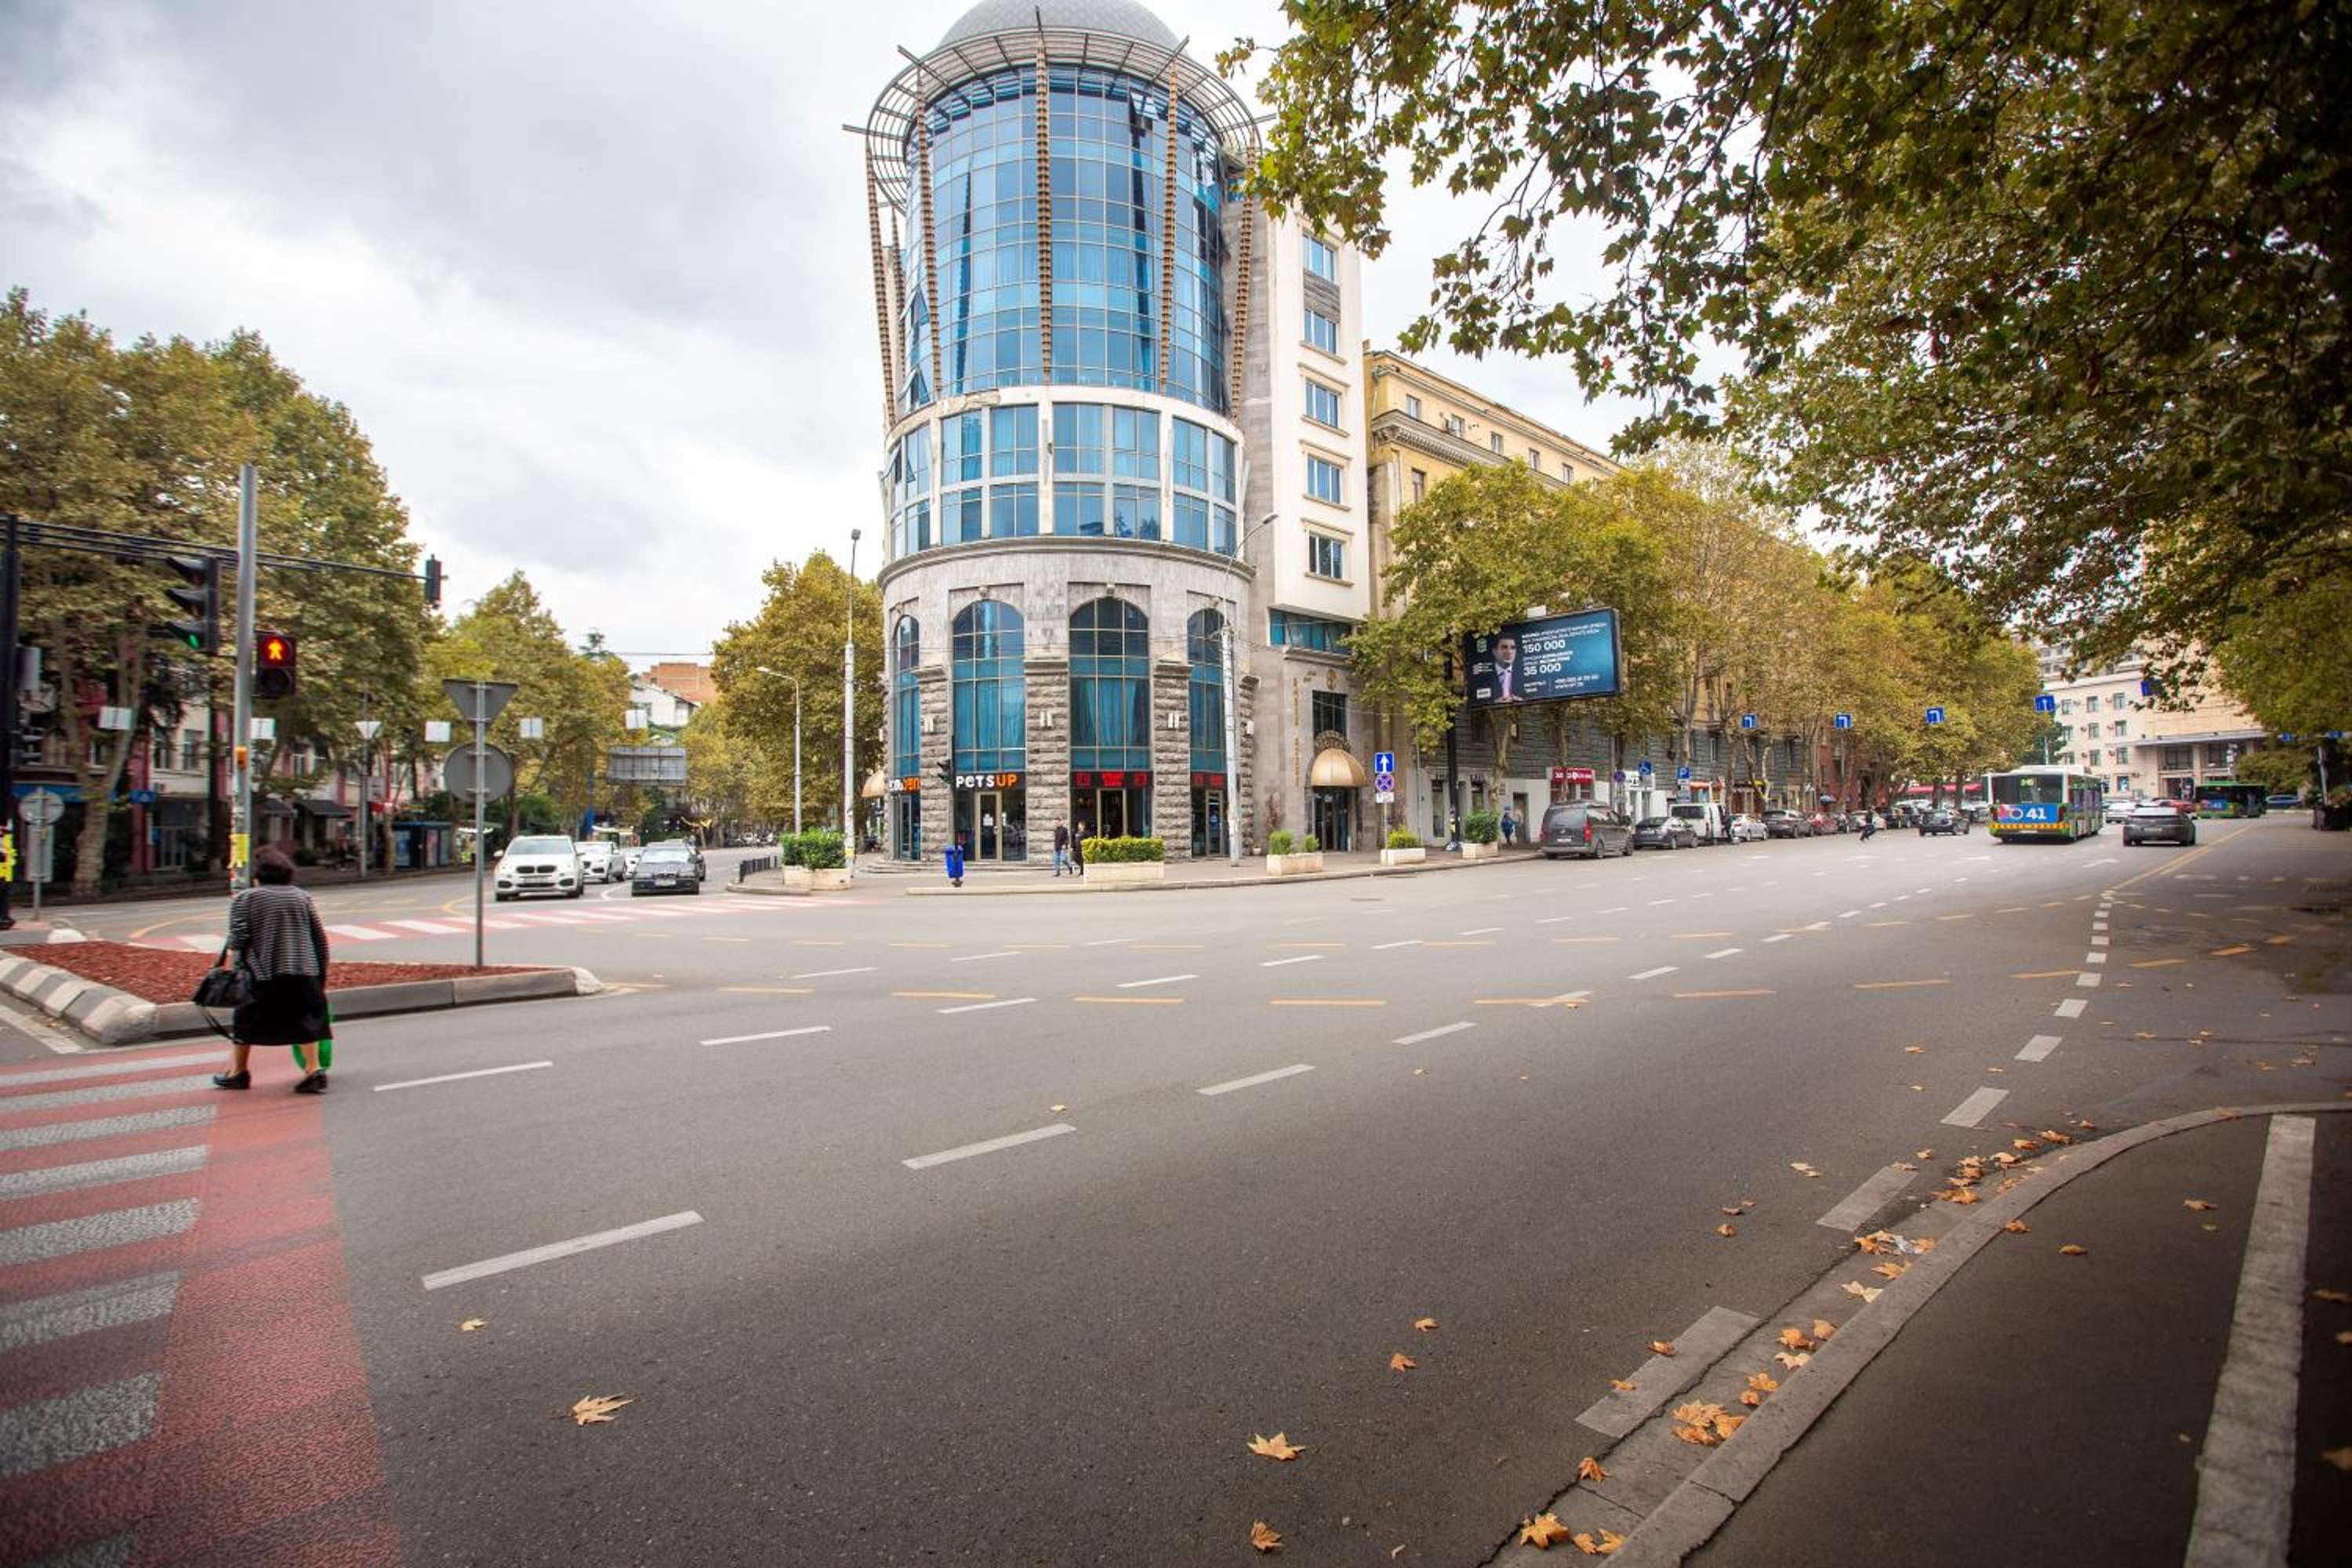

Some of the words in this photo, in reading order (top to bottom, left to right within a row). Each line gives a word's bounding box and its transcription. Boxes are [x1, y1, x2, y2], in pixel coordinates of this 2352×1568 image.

[1523, 643, 1541, 653] 150
[1544, 640, 1566, 651] 000
[1523, 666, 1537, 677] 35
[1539, 663, 1561, 673] 000
[2026, 808, 2047, 819] 41
